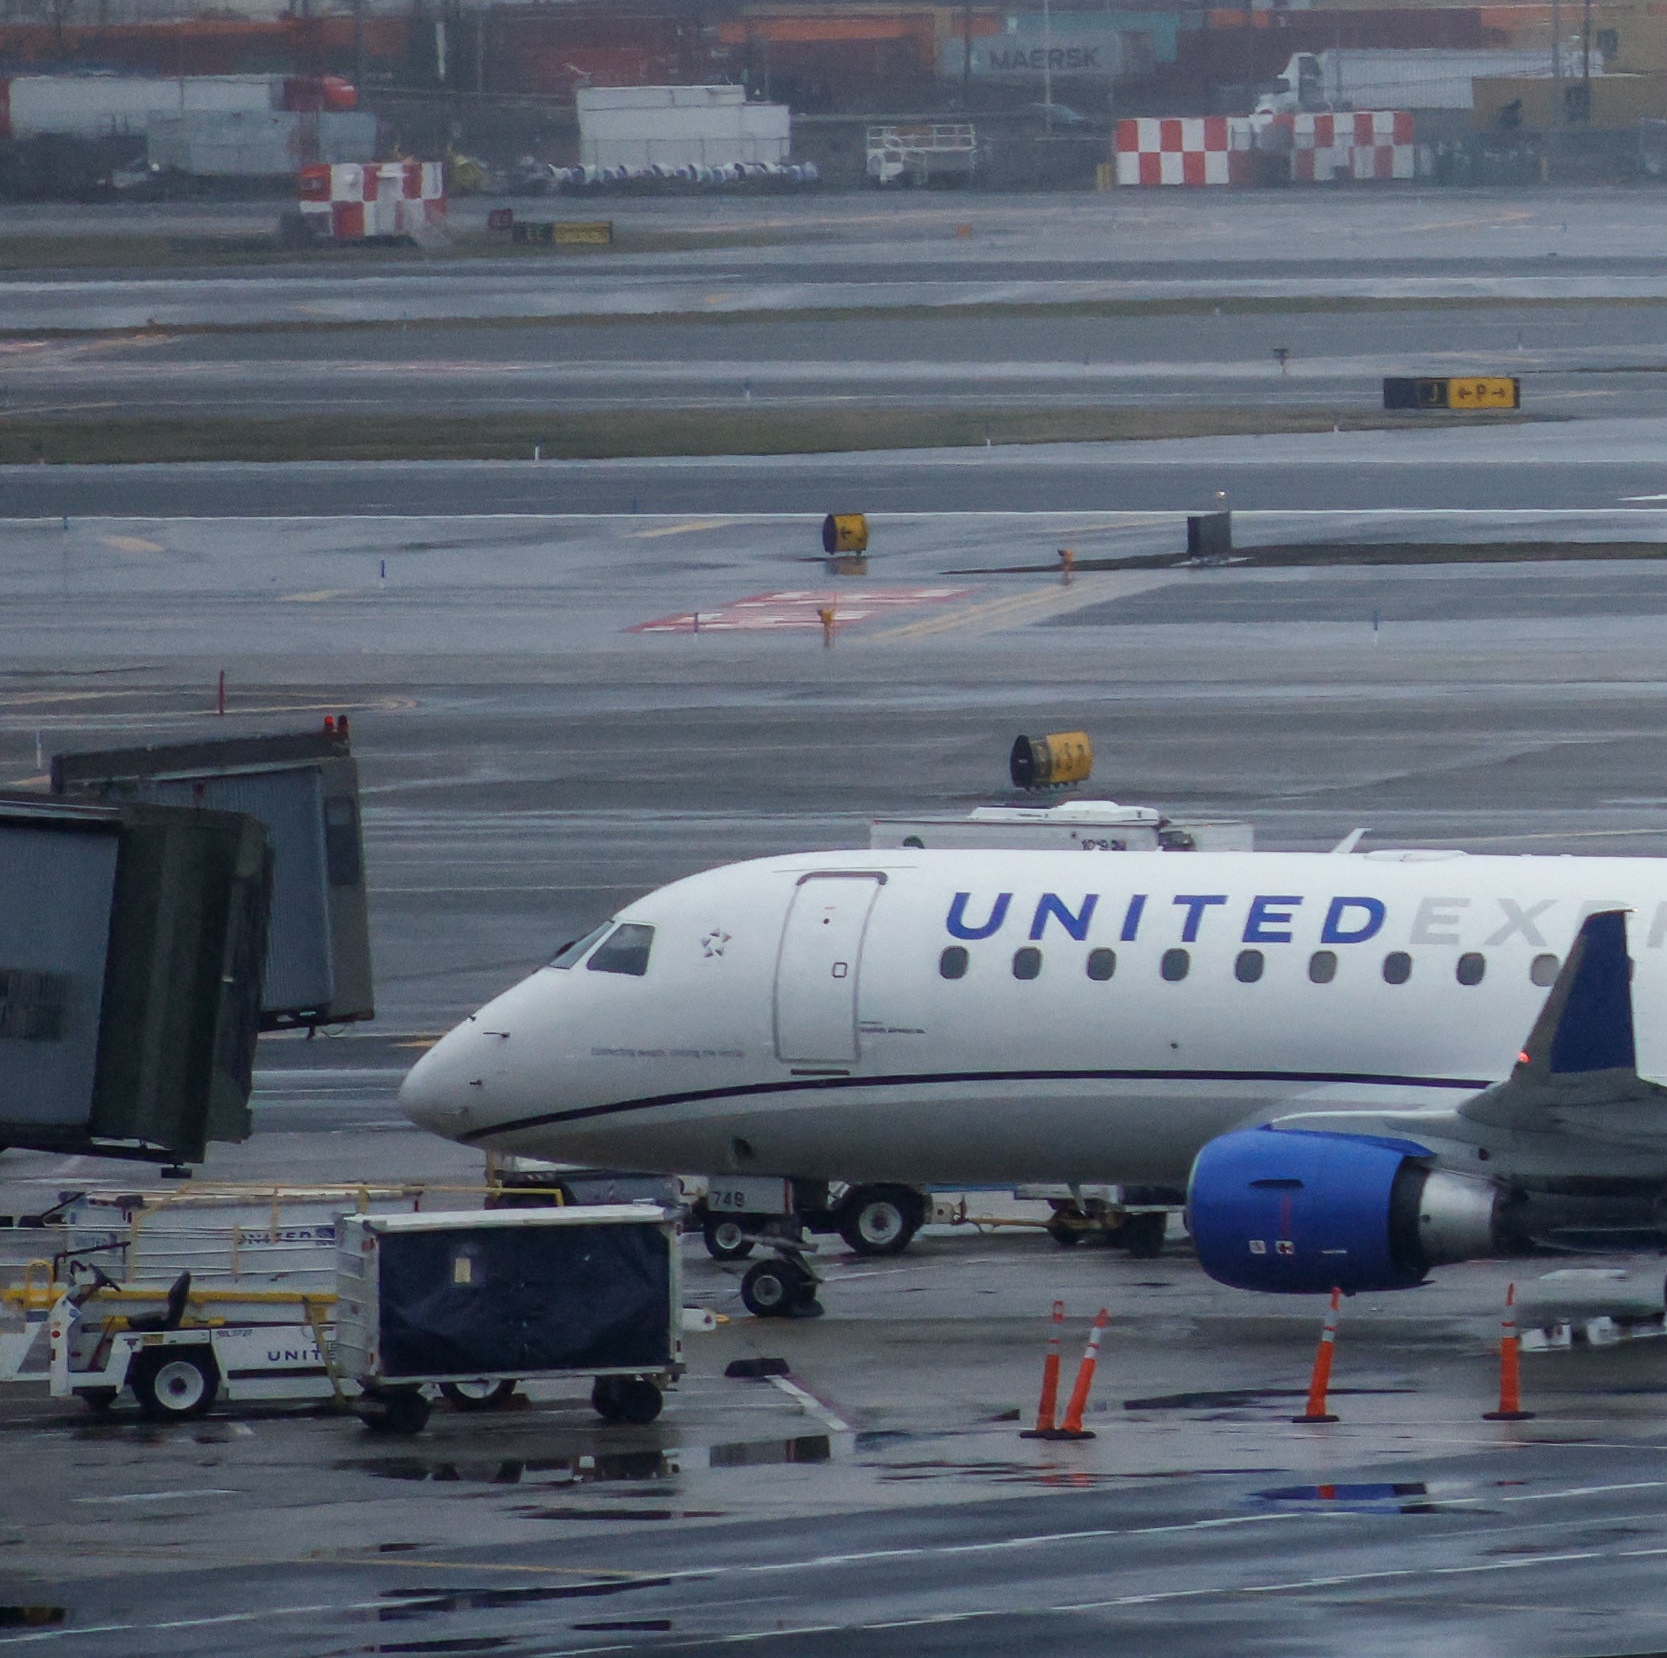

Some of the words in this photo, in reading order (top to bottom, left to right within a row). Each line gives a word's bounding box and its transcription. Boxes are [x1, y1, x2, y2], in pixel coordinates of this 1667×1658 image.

[989, 47, 1100, 70] MAERSK
[1476, 384, 1487, 402] P
[945, 892, 1387, 943] UNITED
